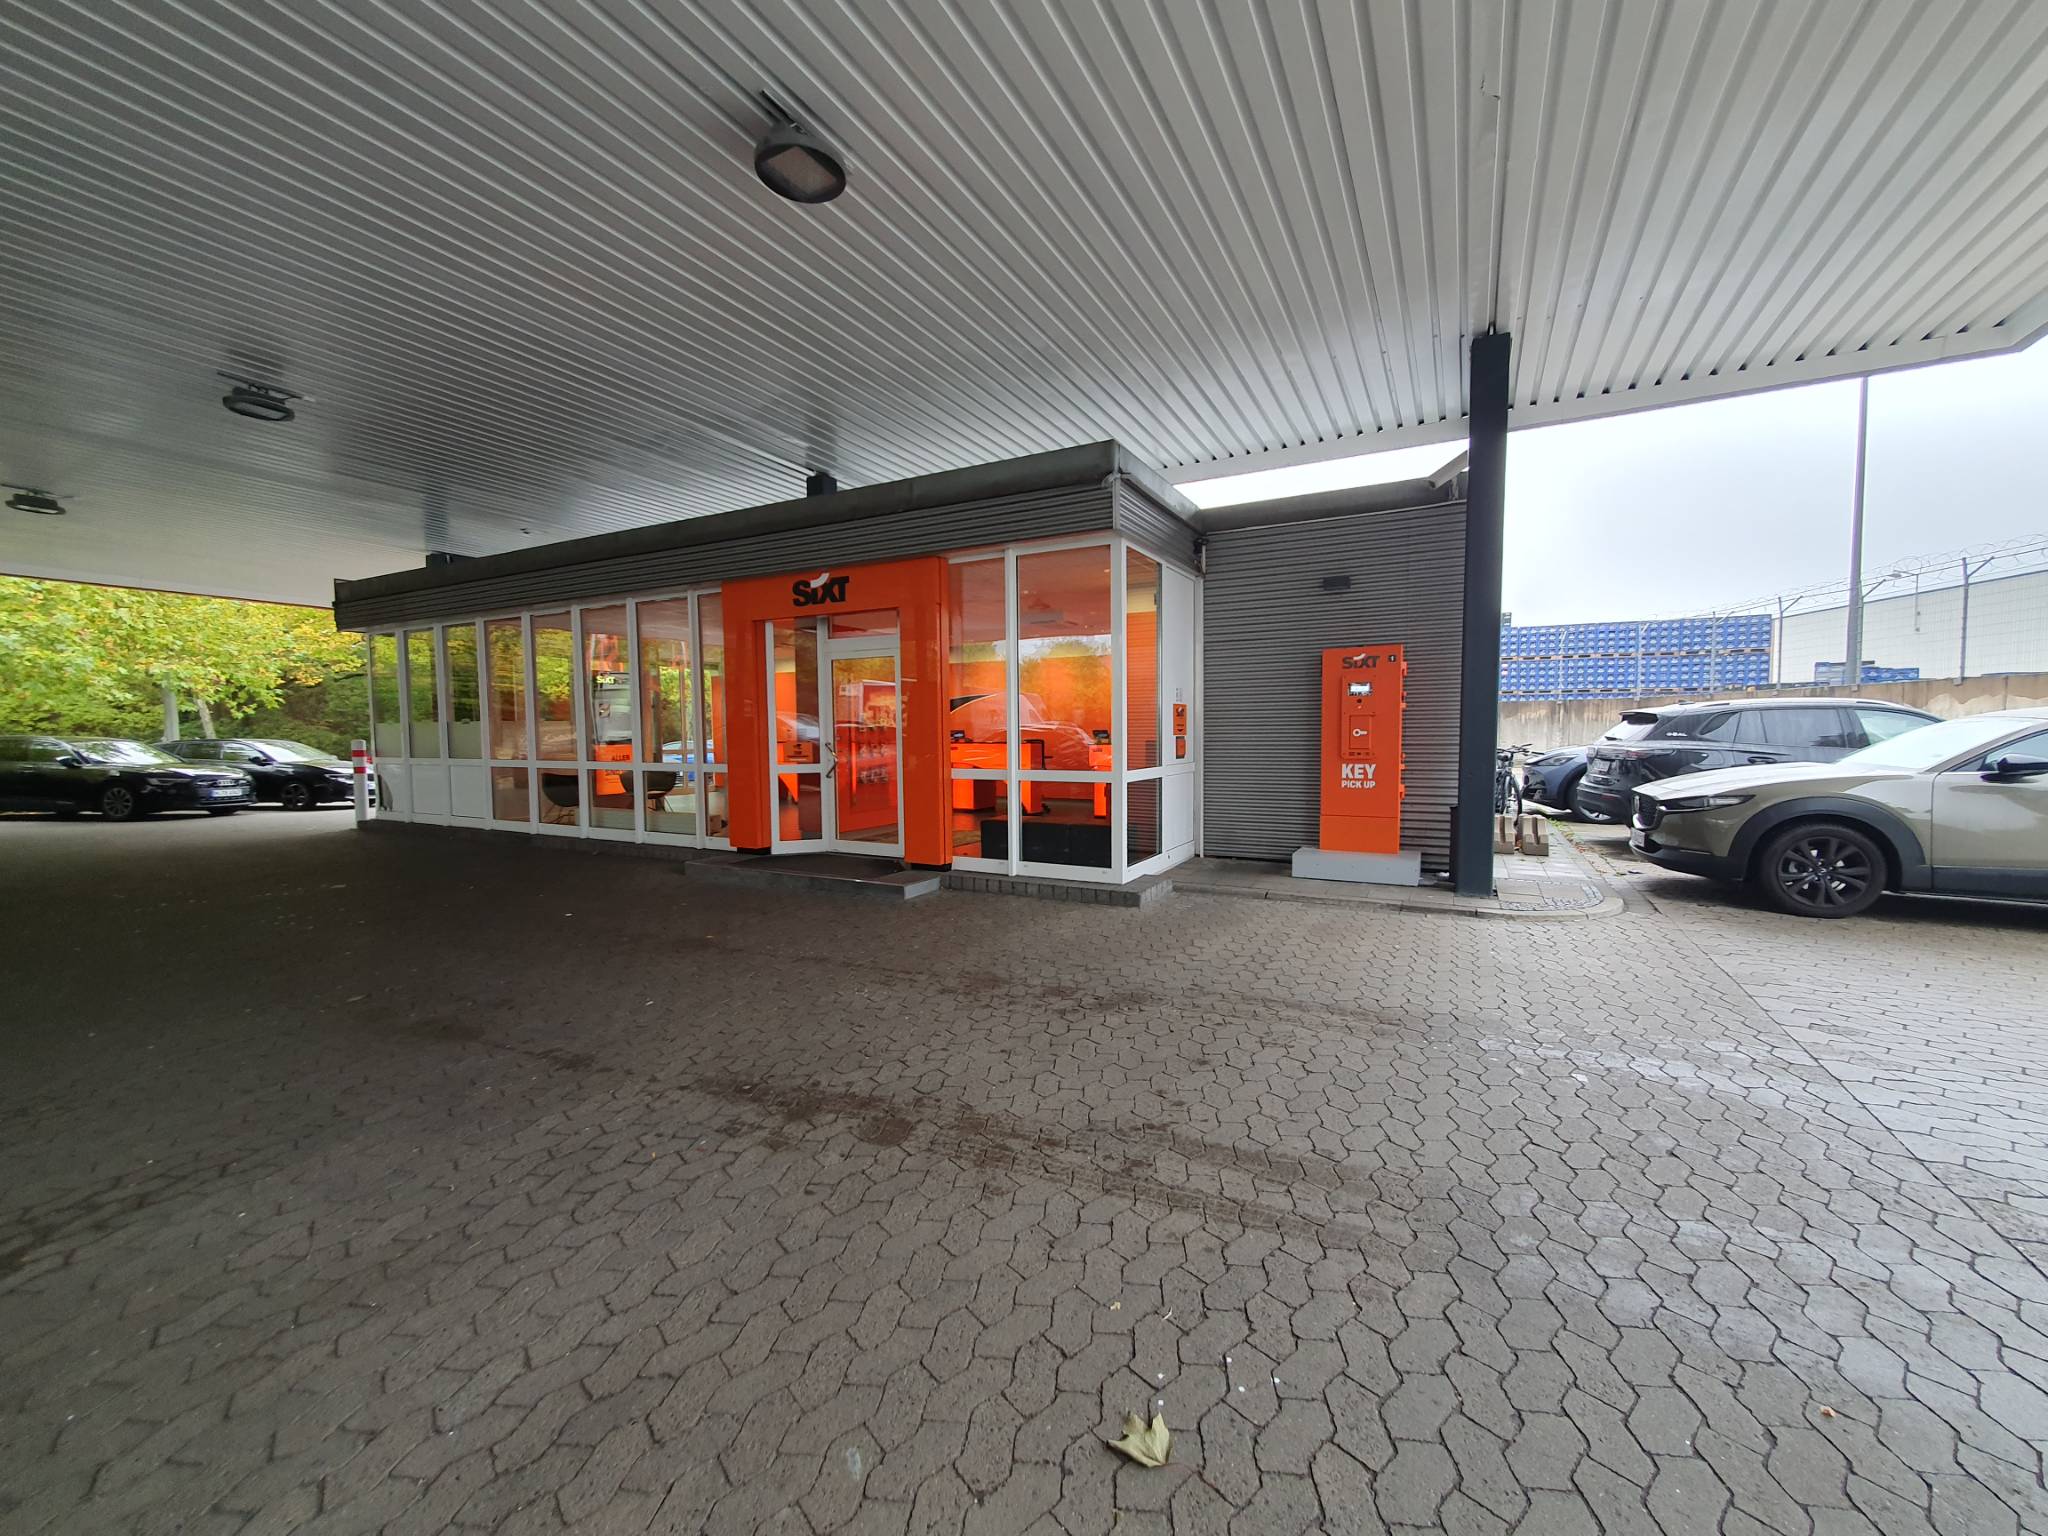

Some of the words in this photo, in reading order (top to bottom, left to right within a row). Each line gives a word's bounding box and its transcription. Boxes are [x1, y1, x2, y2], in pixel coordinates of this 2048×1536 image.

[792, 573, 850, 607] SIXT
[1342, 653, 1381, 669] SIXT
[1341, 763, 1377, 779] KEY
[1341, 780, 1363, 789] PICK
[1363, 780, 1377, 789] UP
